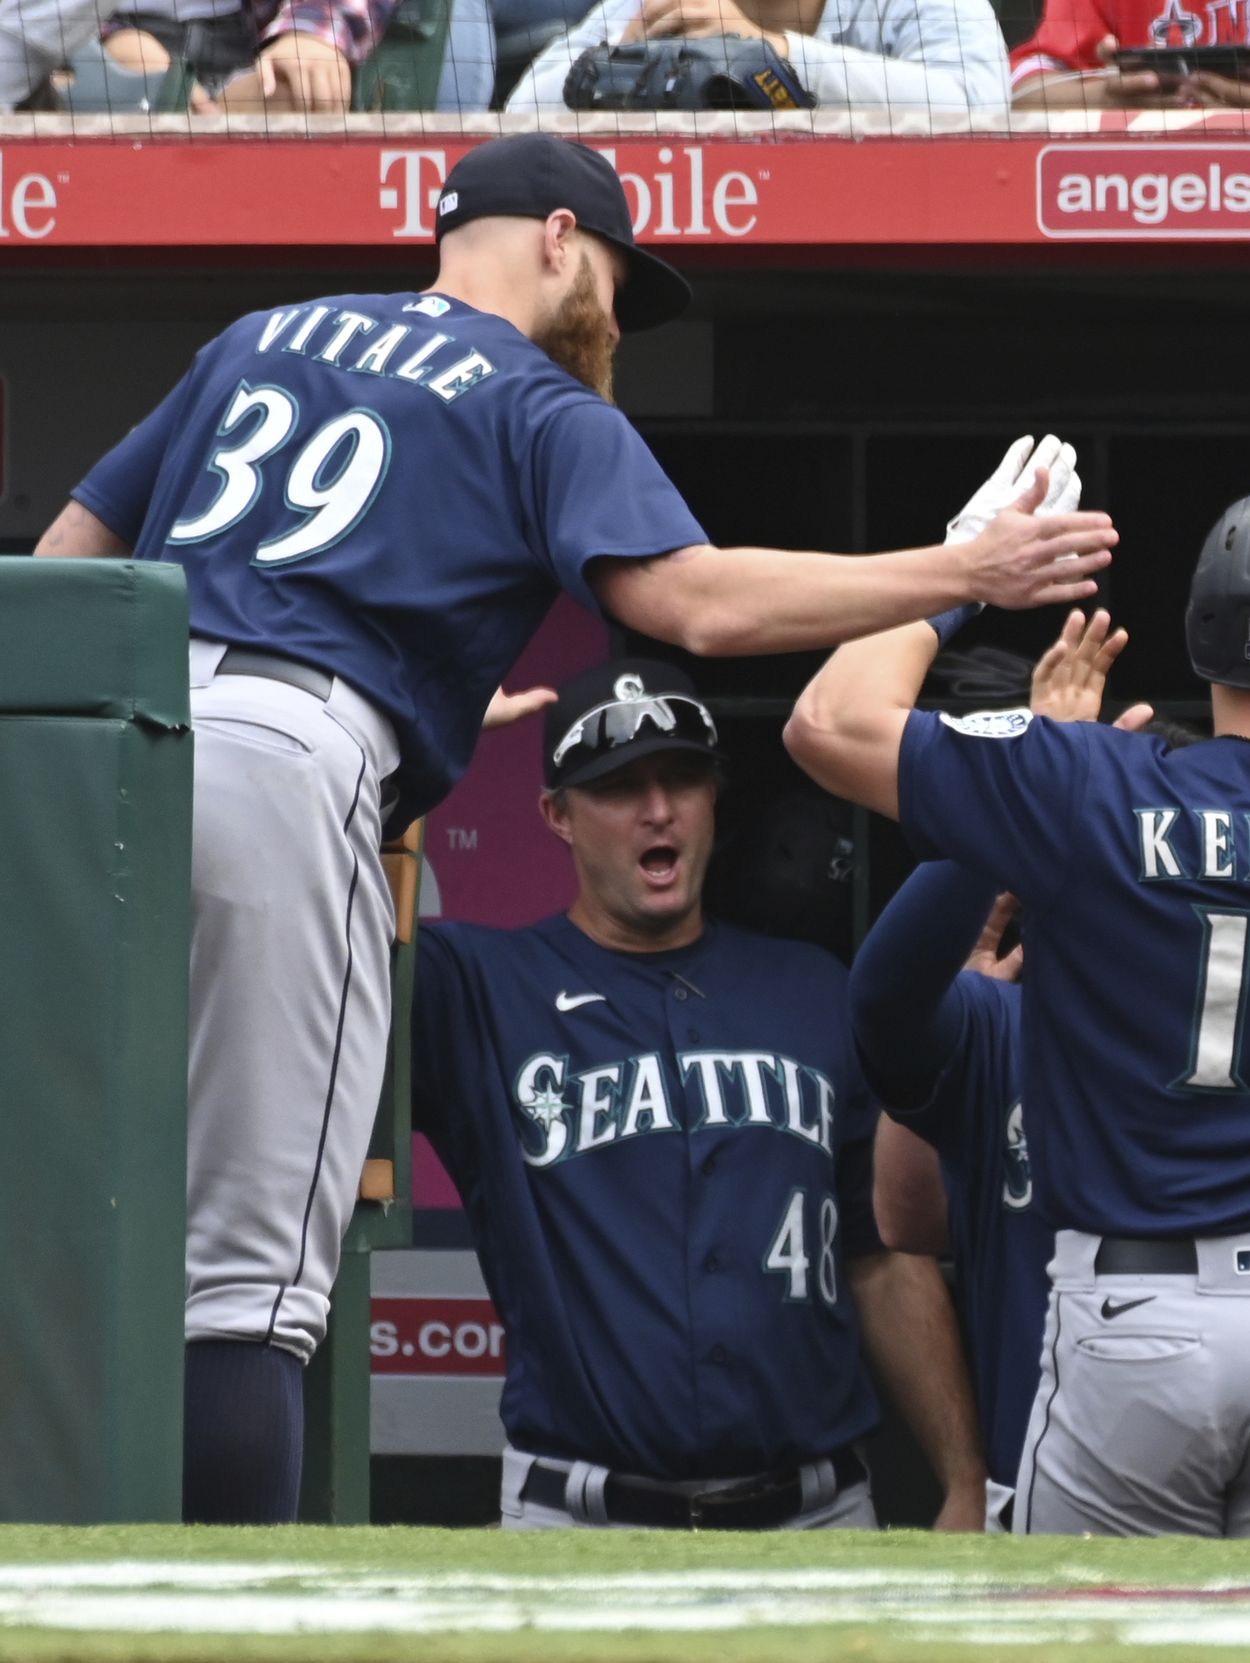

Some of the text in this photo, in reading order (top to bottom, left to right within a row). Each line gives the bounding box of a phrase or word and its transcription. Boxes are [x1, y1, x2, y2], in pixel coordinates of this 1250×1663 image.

[255, 305, 498, 405] VITALE
[165, 378, 393, 567] 39
[763, 1188, 838, 1305] 48
